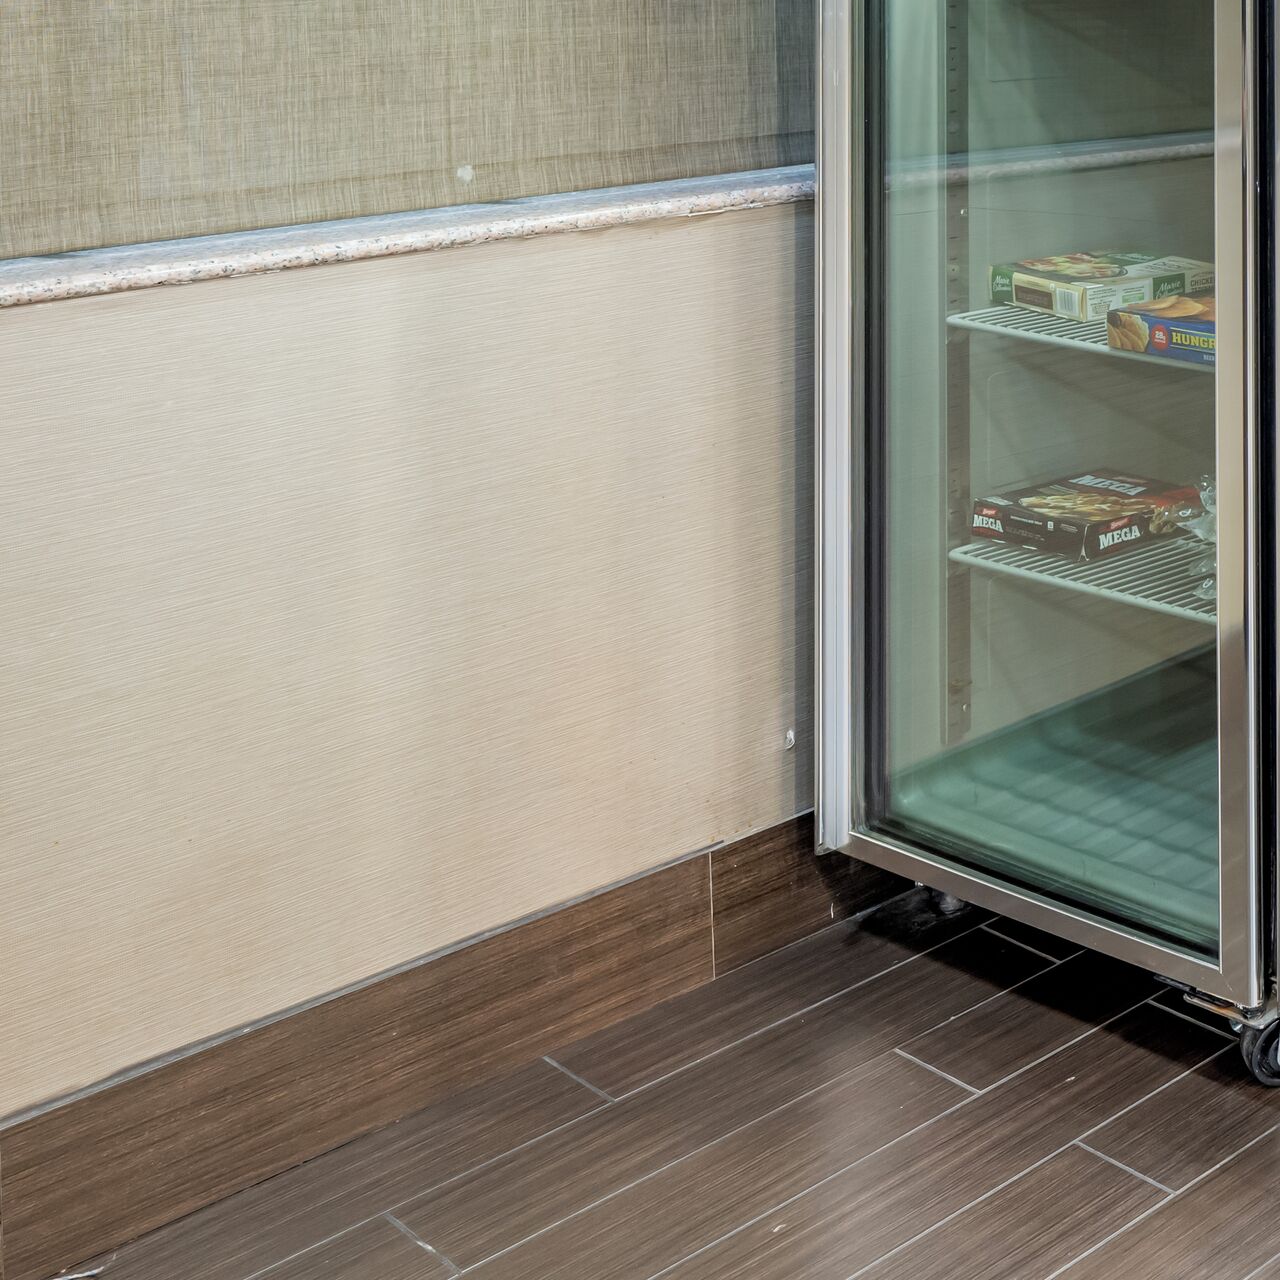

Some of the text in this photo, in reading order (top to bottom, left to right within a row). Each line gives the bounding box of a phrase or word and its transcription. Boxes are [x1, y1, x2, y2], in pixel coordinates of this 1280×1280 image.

[1190, 279, 1214, 288] CHICKE
[1172, 331, 1214, 348] HUNGR
[1070, 474, 1147, 496] MEGA
[973, 514, 1004, 533] MEGA
[1099, 525, 1140, 550] MEGA
